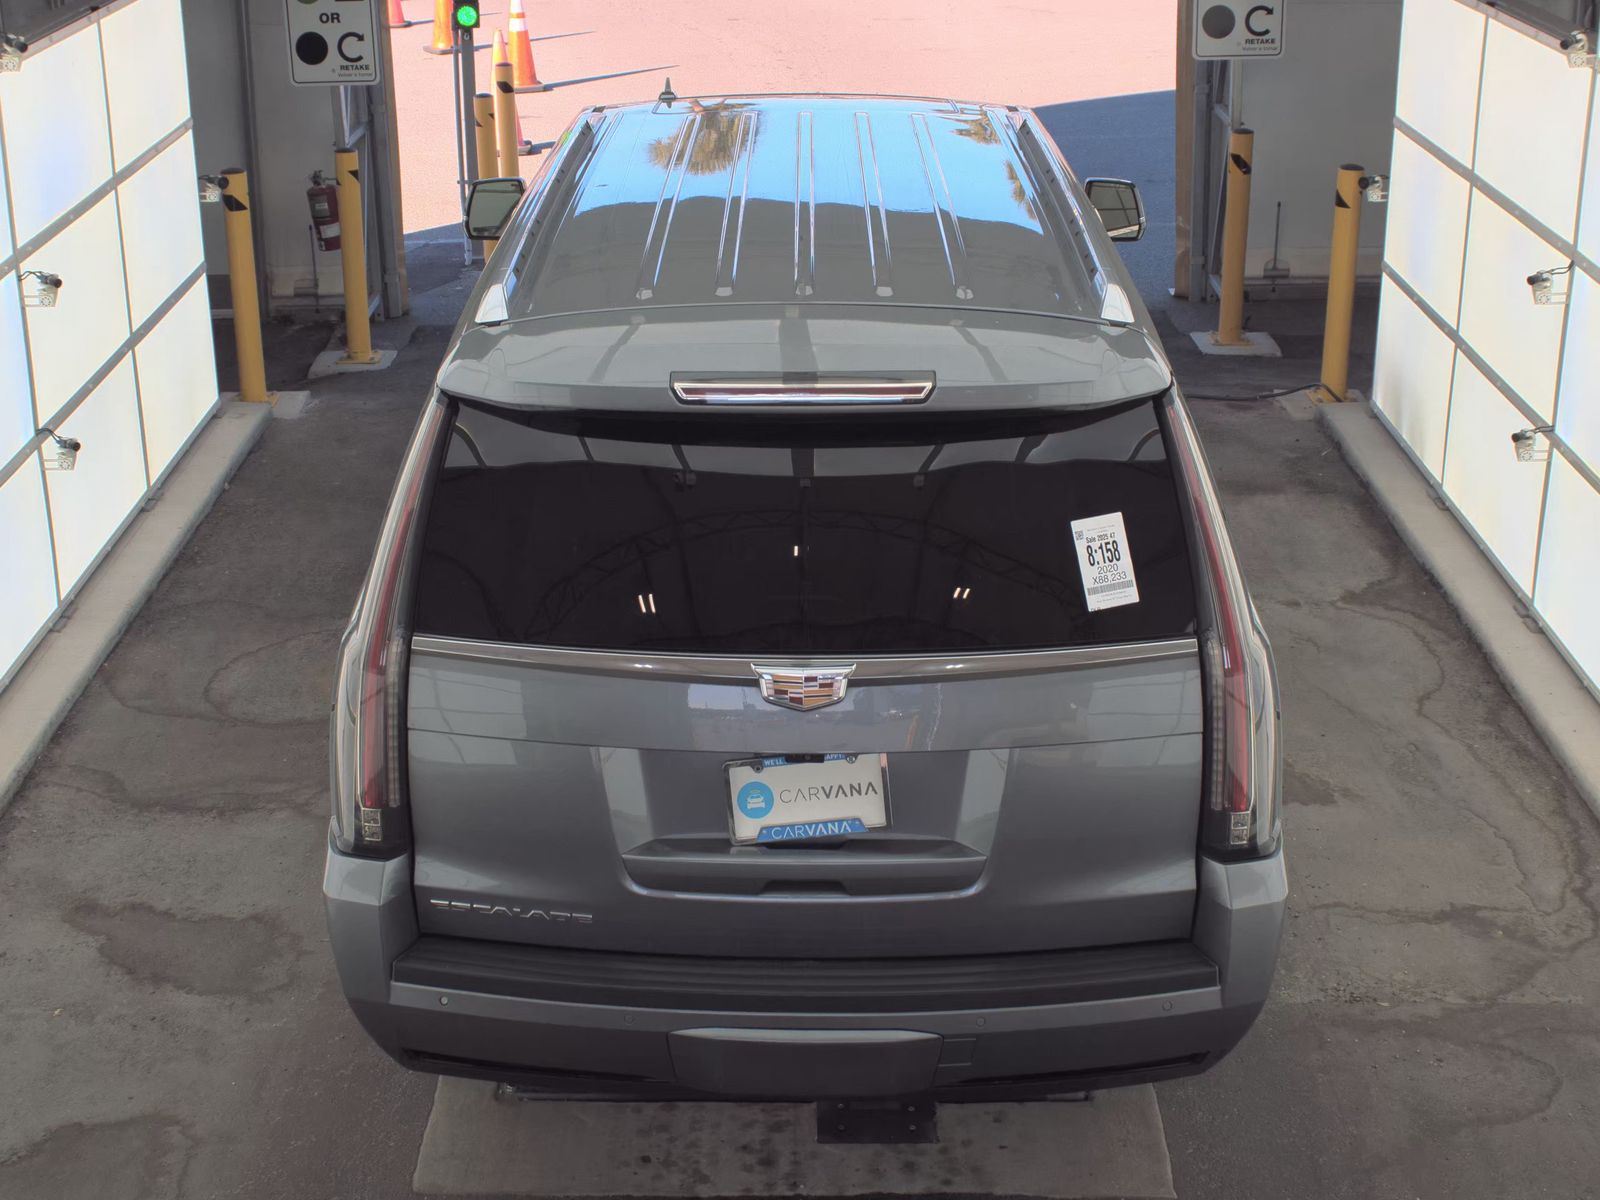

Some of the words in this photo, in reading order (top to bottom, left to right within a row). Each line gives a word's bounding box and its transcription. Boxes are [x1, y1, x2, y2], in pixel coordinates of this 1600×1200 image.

[319, 12, 341, 24] OR
[1086, 535, 1096, 544] Sale
[1086, 540, 1121, 567] 8:158
[1097, 563, 1119, 575] 2020
[1092, 571, 1127, 585] X88,233
[779, 781, 878, 804] CARVANA
[771, 821, 851, 839] CARVANA
